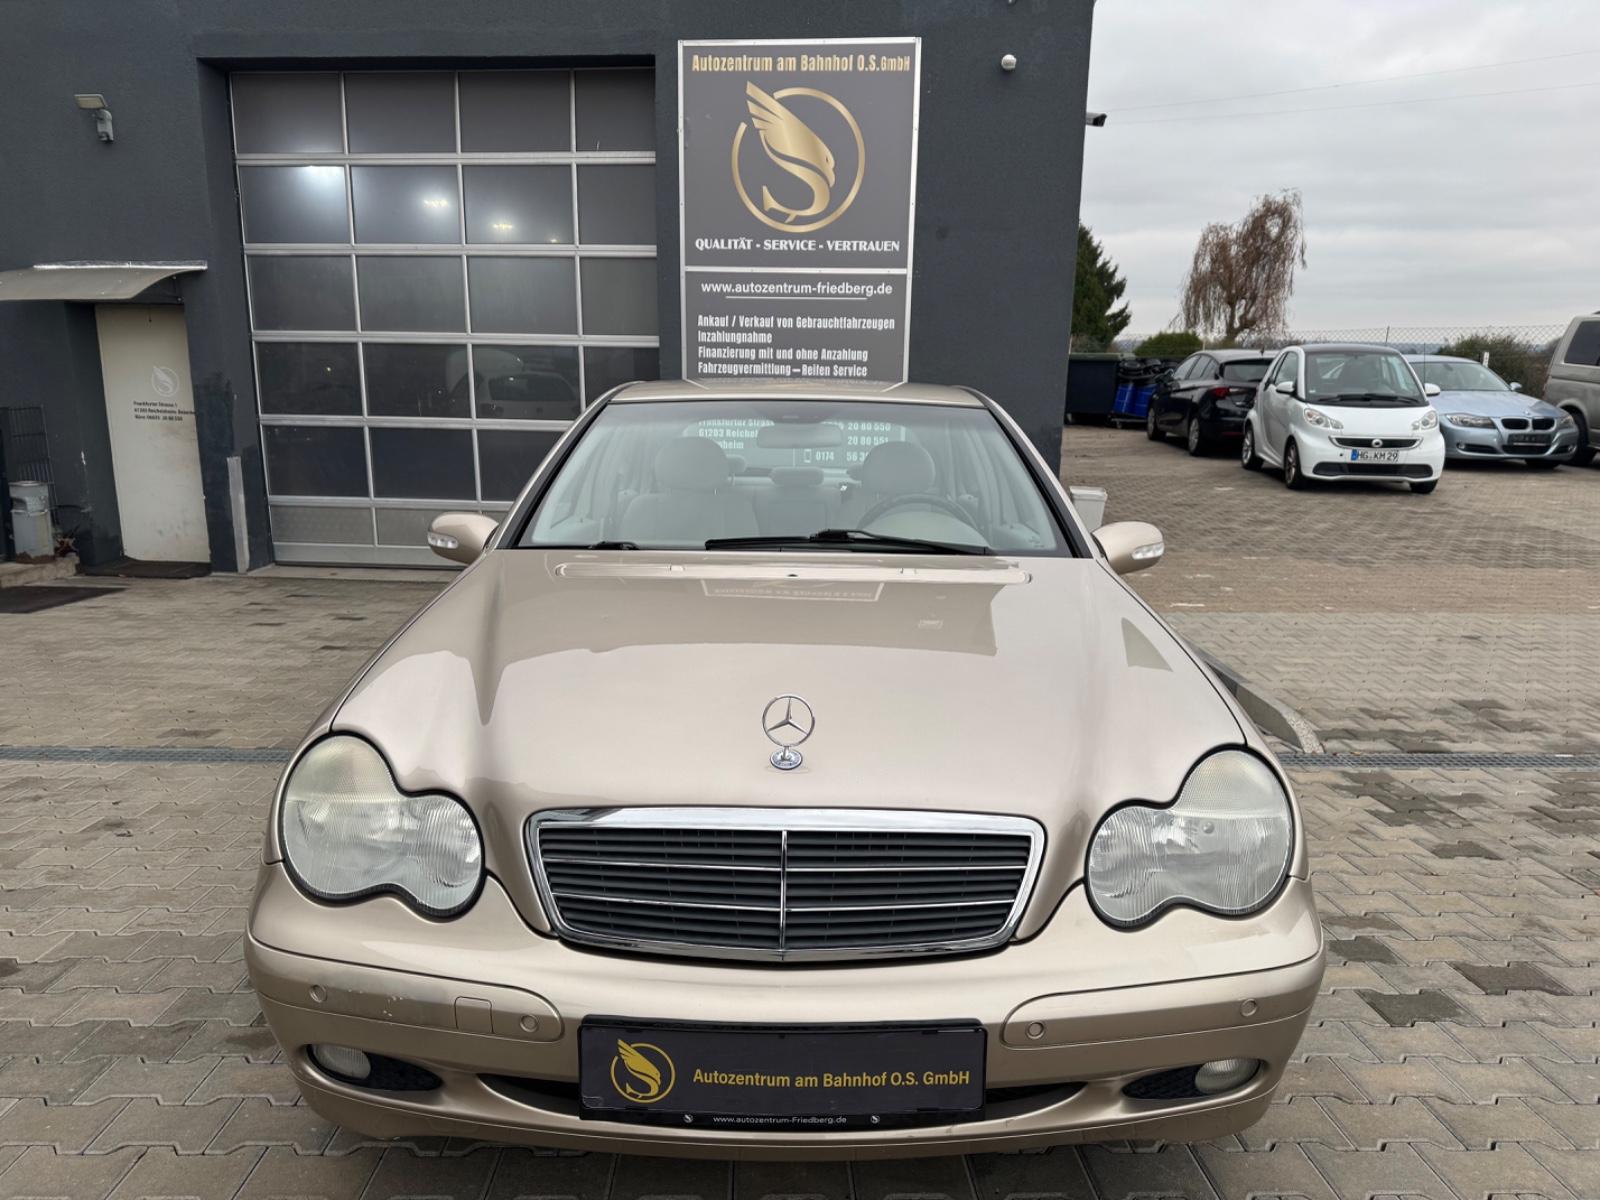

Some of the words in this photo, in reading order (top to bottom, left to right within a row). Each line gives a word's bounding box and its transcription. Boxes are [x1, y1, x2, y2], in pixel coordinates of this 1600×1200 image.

[692, 54, 773, 72] Autozentrum
[777, 57, 796, 71] am
[800, 54, 853, 72] Bahnhof
[695, 237, 753, 251] QUALITÄT
[763, 239, 817, 251] SERVICE
[827, 240, 900, 252] VERTRAUEN
[701, 281, 893, 297] www.autozentrum-friedberg.de
[698, 314, 729, 327] Ankauf
[739, 315, 775, 328] Verkauf
[777, 318, 793, 328] von
[796, 316, 895, 330] Gebrauchtfahrzeugen
[698, 331, 772, 344] Inzahlungnahme
[698, 346, 756, 361] Finanzierung
[758, 348, 774, 360] mit
[776, 348, 793, 360] und
[796, 349, 818, 361] ohne
[821, 349, 868, 362] Anzahlung
[833, 364, 868, 377] Service
[693, 1069, 790, 1088] Autozentrum
[795, 1075, 818, 1088] am
[823, 1072, 887, 1088] Bahnhof
[890, 1072, 919, 1086] O.S.
[923, 1070, 970, 1085] GmbH
[713, 1115, 847, 1126] www.autozentrum-Friedberg.de
